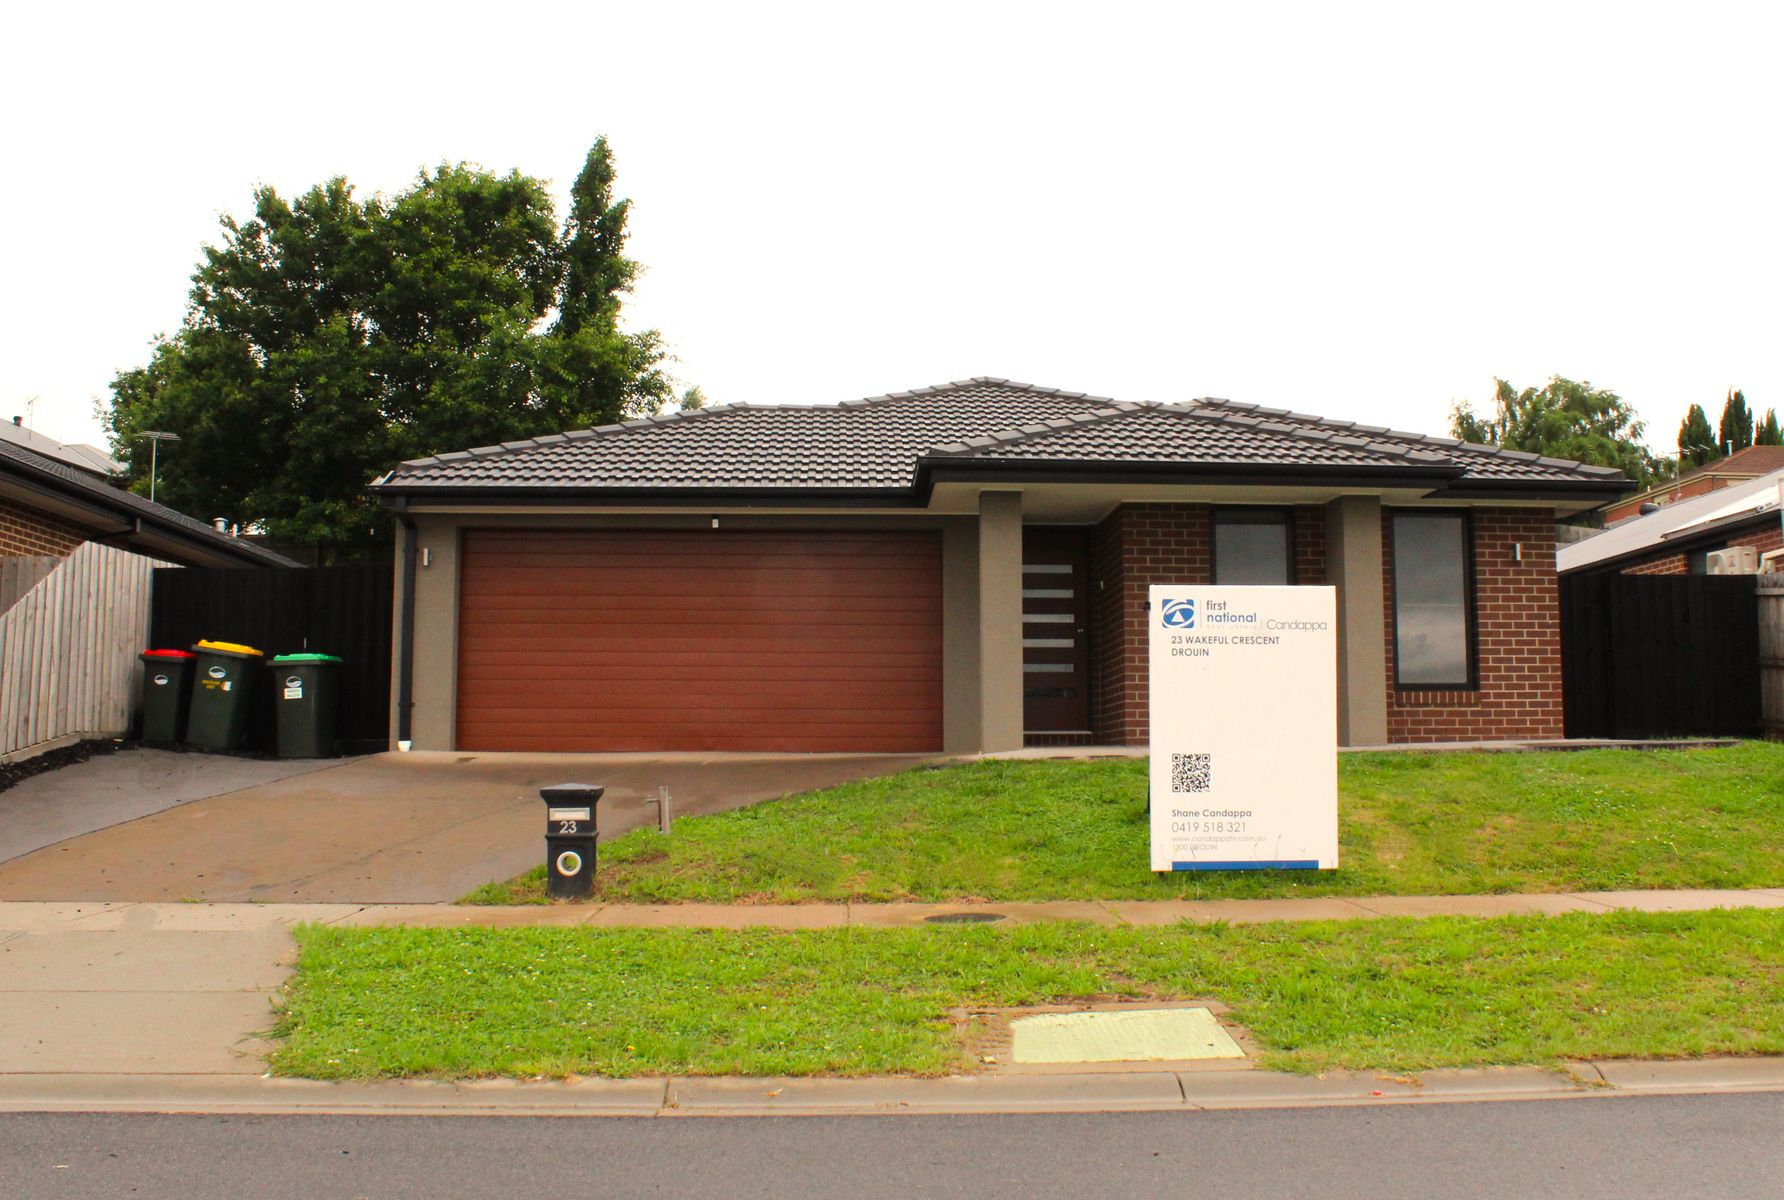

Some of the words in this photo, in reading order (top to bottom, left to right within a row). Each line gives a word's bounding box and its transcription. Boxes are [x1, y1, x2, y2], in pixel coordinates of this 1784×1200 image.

[1206, 600, 1227, 611] first
[1207, 612, 1257, 623] national
[1266, 619, 1328, 632] Candappa
[1171, 636, 1183, 645] 23
[1185, 636, 1229, 645] WAKEFUL
[1231, 636, 1280, 645] CRESCENT
[1171, 648, 1209, 657] DROUIN
[1171, 809, 1200, 817] Shane
[1202, 809, 1252, 819] Candappa
[560, 820, 577, 834] 23
[1171, 822, 1200, 833] 0419
[1202, 822, 1224, 833] 518
[1226, 822, 1246, 833] 321
